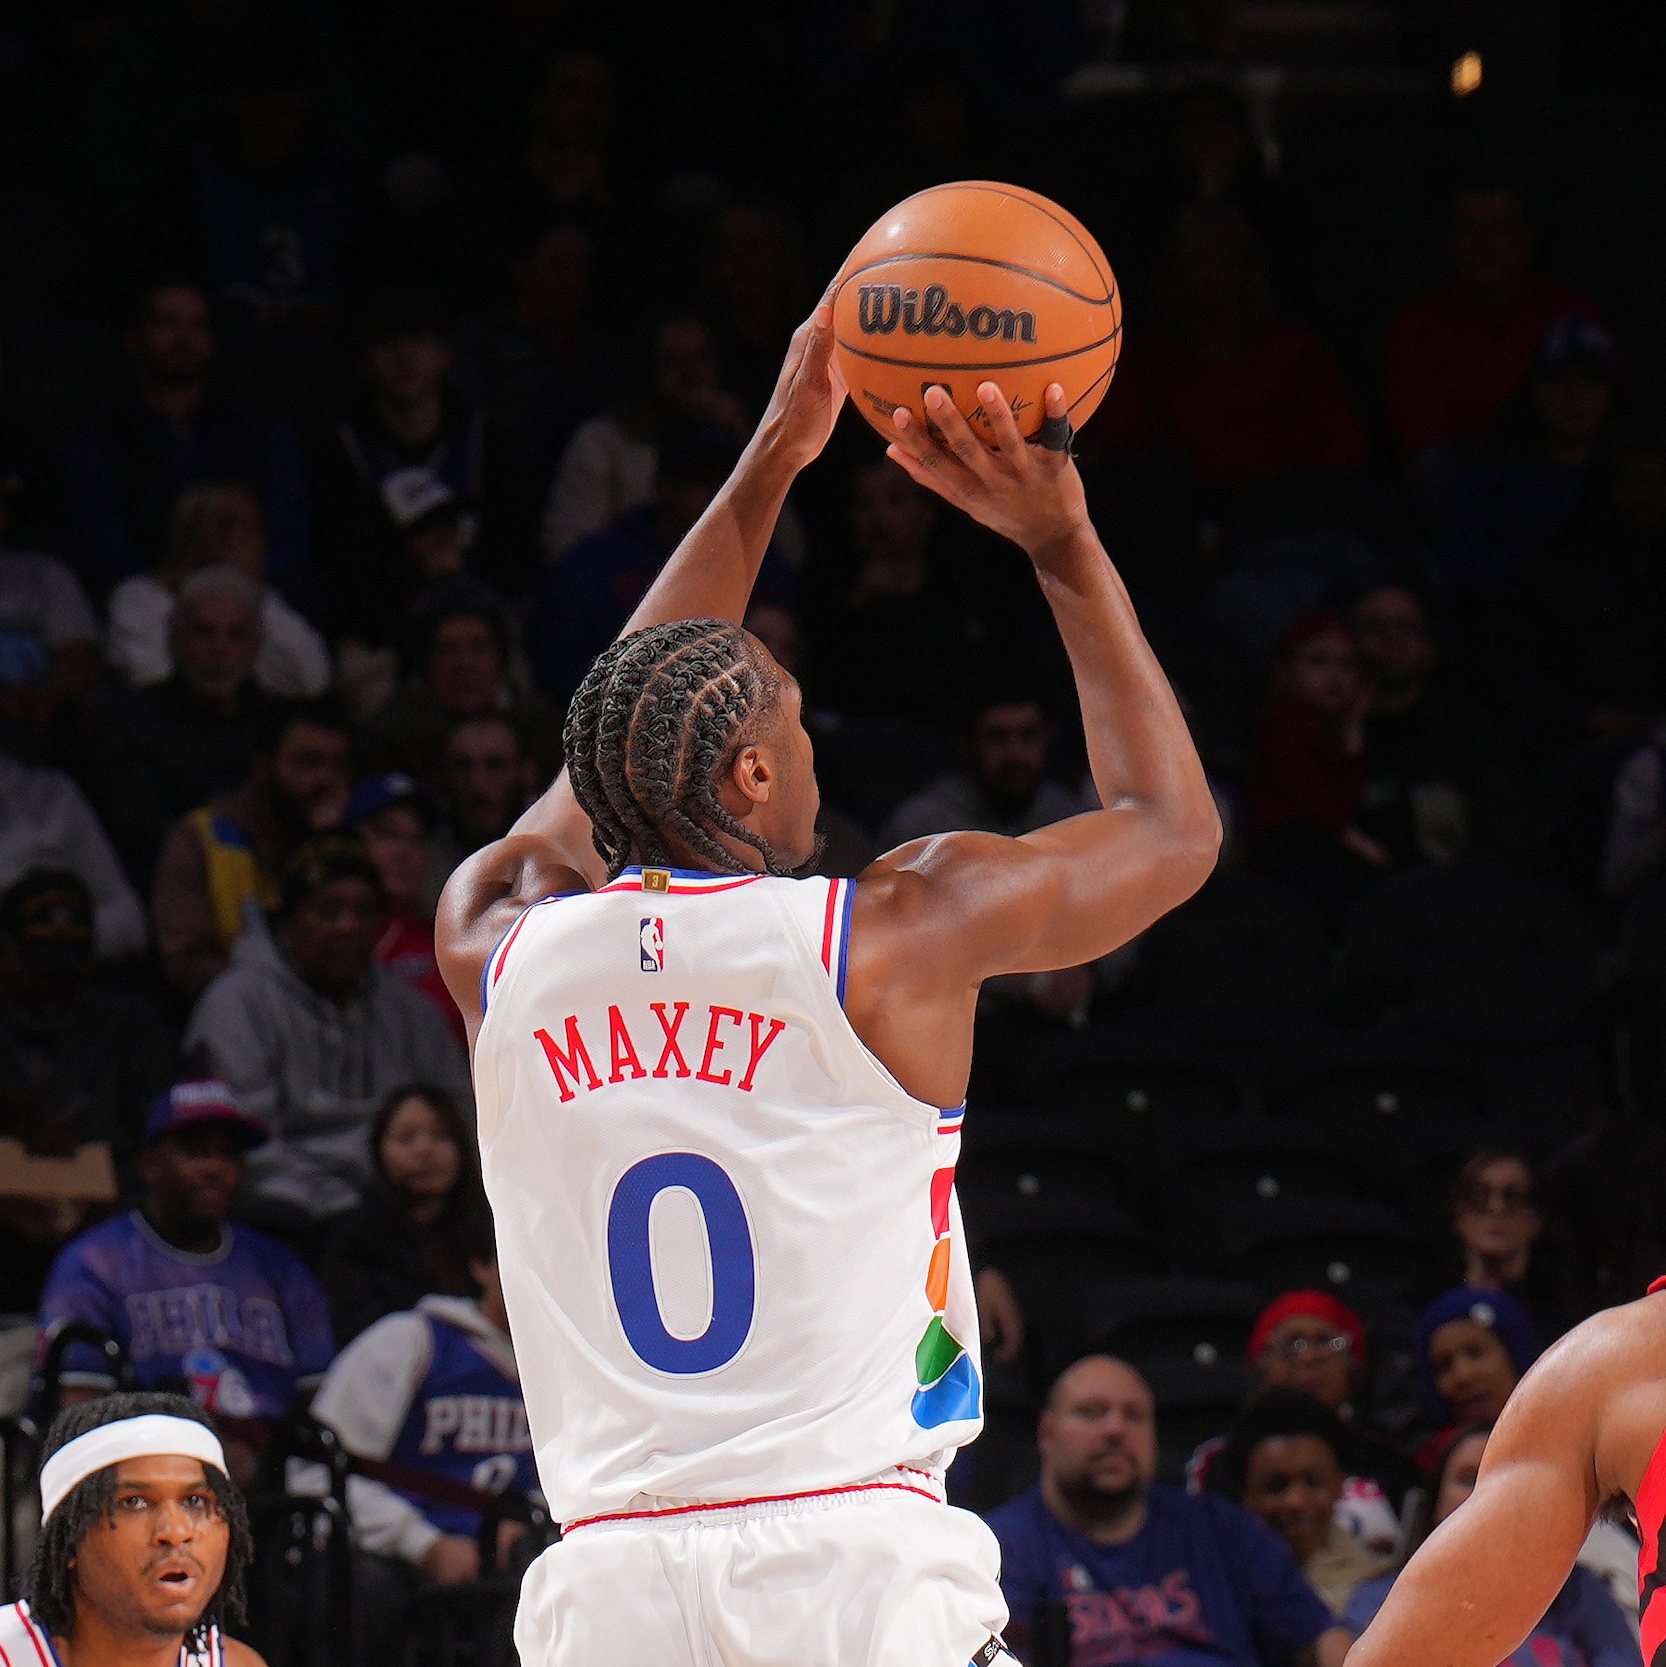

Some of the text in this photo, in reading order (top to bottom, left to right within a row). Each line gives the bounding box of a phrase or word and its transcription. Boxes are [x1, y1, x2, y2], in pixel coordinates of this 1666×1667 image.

[858, 283, 1037, 344] Wilson
[533, 1001, 786, 1103] MAXEY
[607, 1151, 756, 1375] 0
